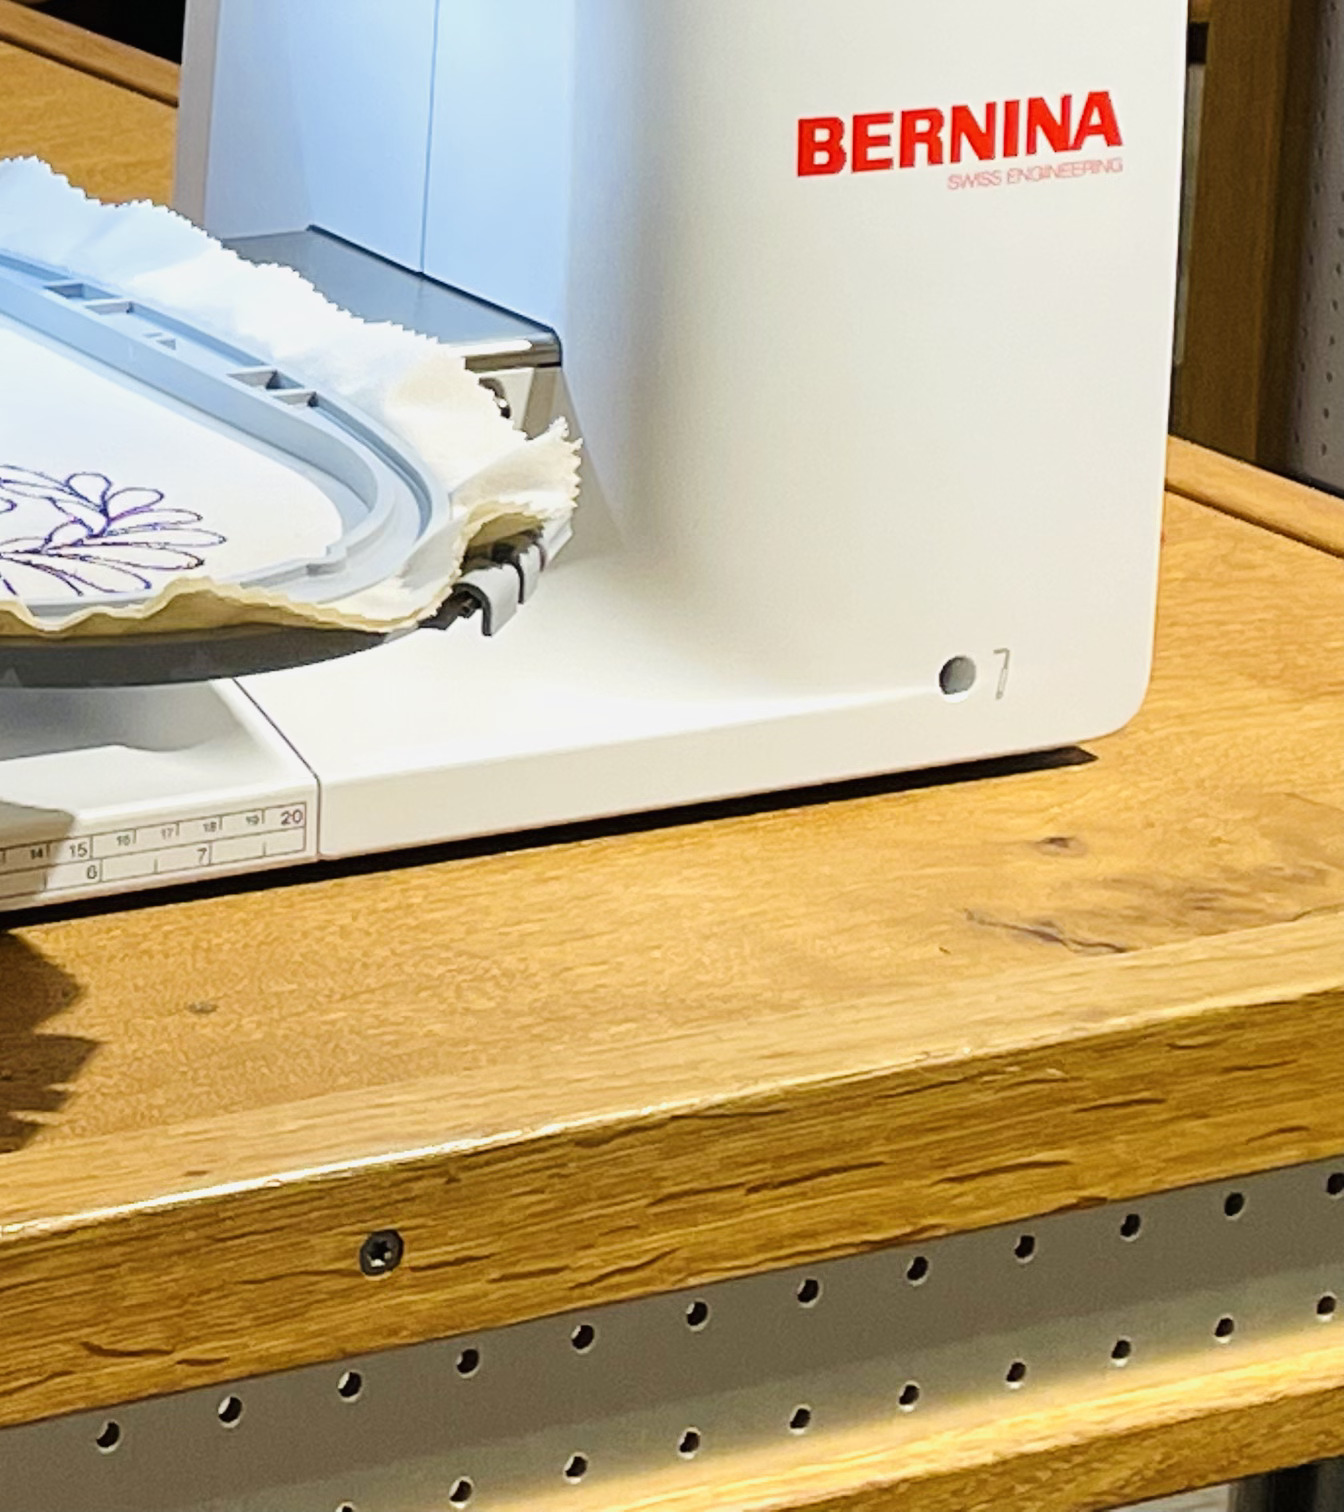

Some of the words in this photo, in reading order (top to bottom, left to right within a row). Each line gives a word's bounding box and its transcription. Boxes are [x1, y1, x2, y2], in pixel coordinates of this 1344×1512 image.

[797, 90, 1123, 177] BERNINA
[947, 170, 1002, 190] SWISS
[1006, 157, 1124, 184] ENGINEERING
[30, 848, 43, 860] 14
[69, 841, 88, 858] 15
[161, 827, 174, 839] 17
[280, 809, 303, 826] 20
[86, 864, 98, 880] 6
[197, 847, 208, 864] 7
